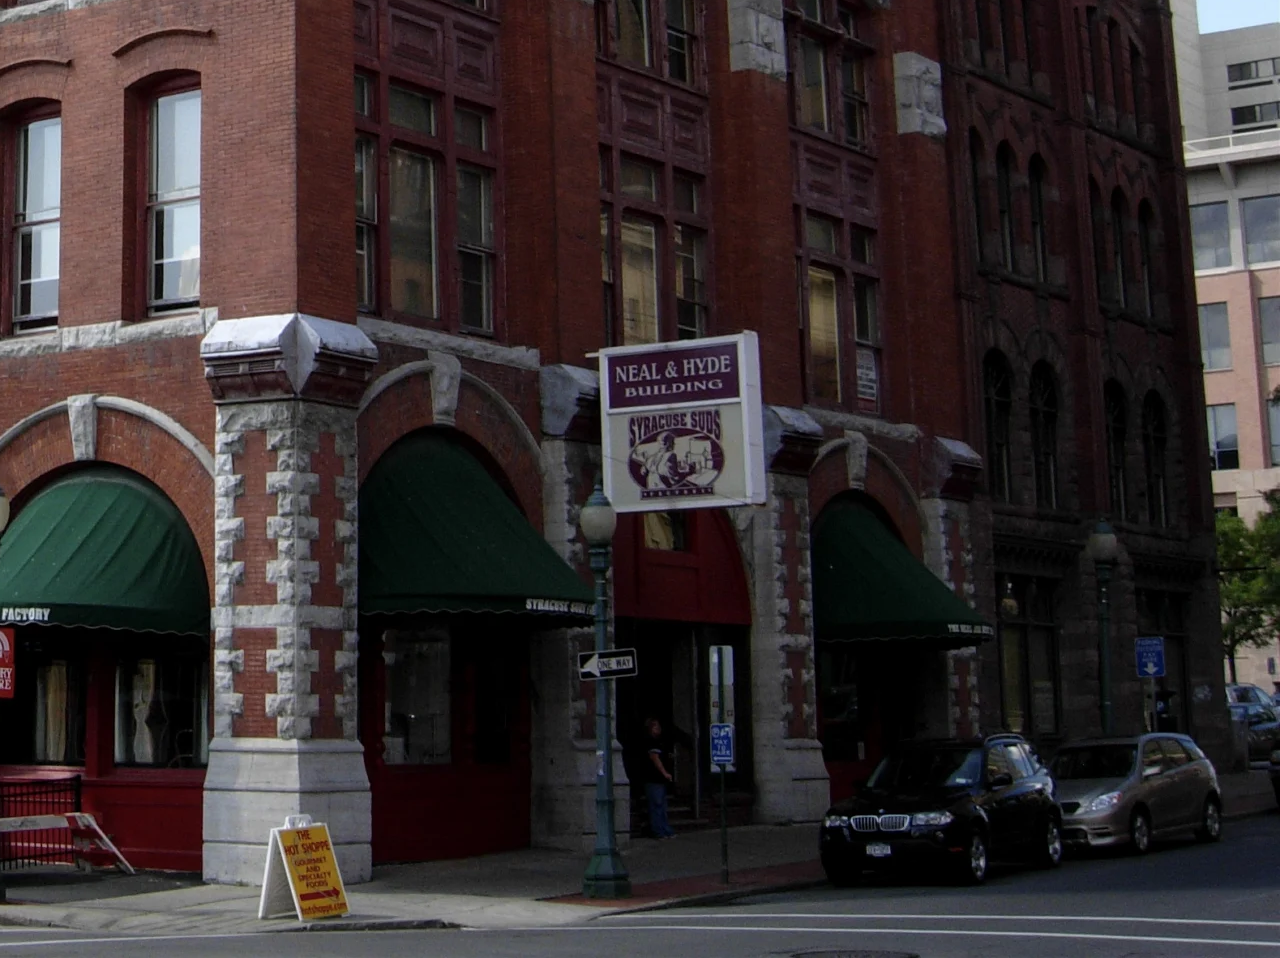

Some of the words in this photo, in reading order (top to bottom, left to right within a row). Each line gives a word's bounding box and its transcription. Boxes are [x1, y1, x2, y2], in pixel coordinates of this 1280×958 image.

[616, 363, 661, 383] NEAL
[665, 361, 678, 378] &
[683, 355, 731, 376] HYDE
[625, 379, 723, 397] BUILDING
[629, 413, 687, 447] SYRACUSE
[690, 409, 722, 440] SUDS
[526, 598, 570, 612] SYRACUSE
[2, 607, 51, 621] FACTORY
[597, 659, 612, 670] ONE
[616, 657, 631, 669] WAY
[296, 830, 312, 840] THE
[284, 845, 300, 856] HOT
[301, 841, 331, 853] SHOPPE
[306, 881, 329, 889] FOODS
